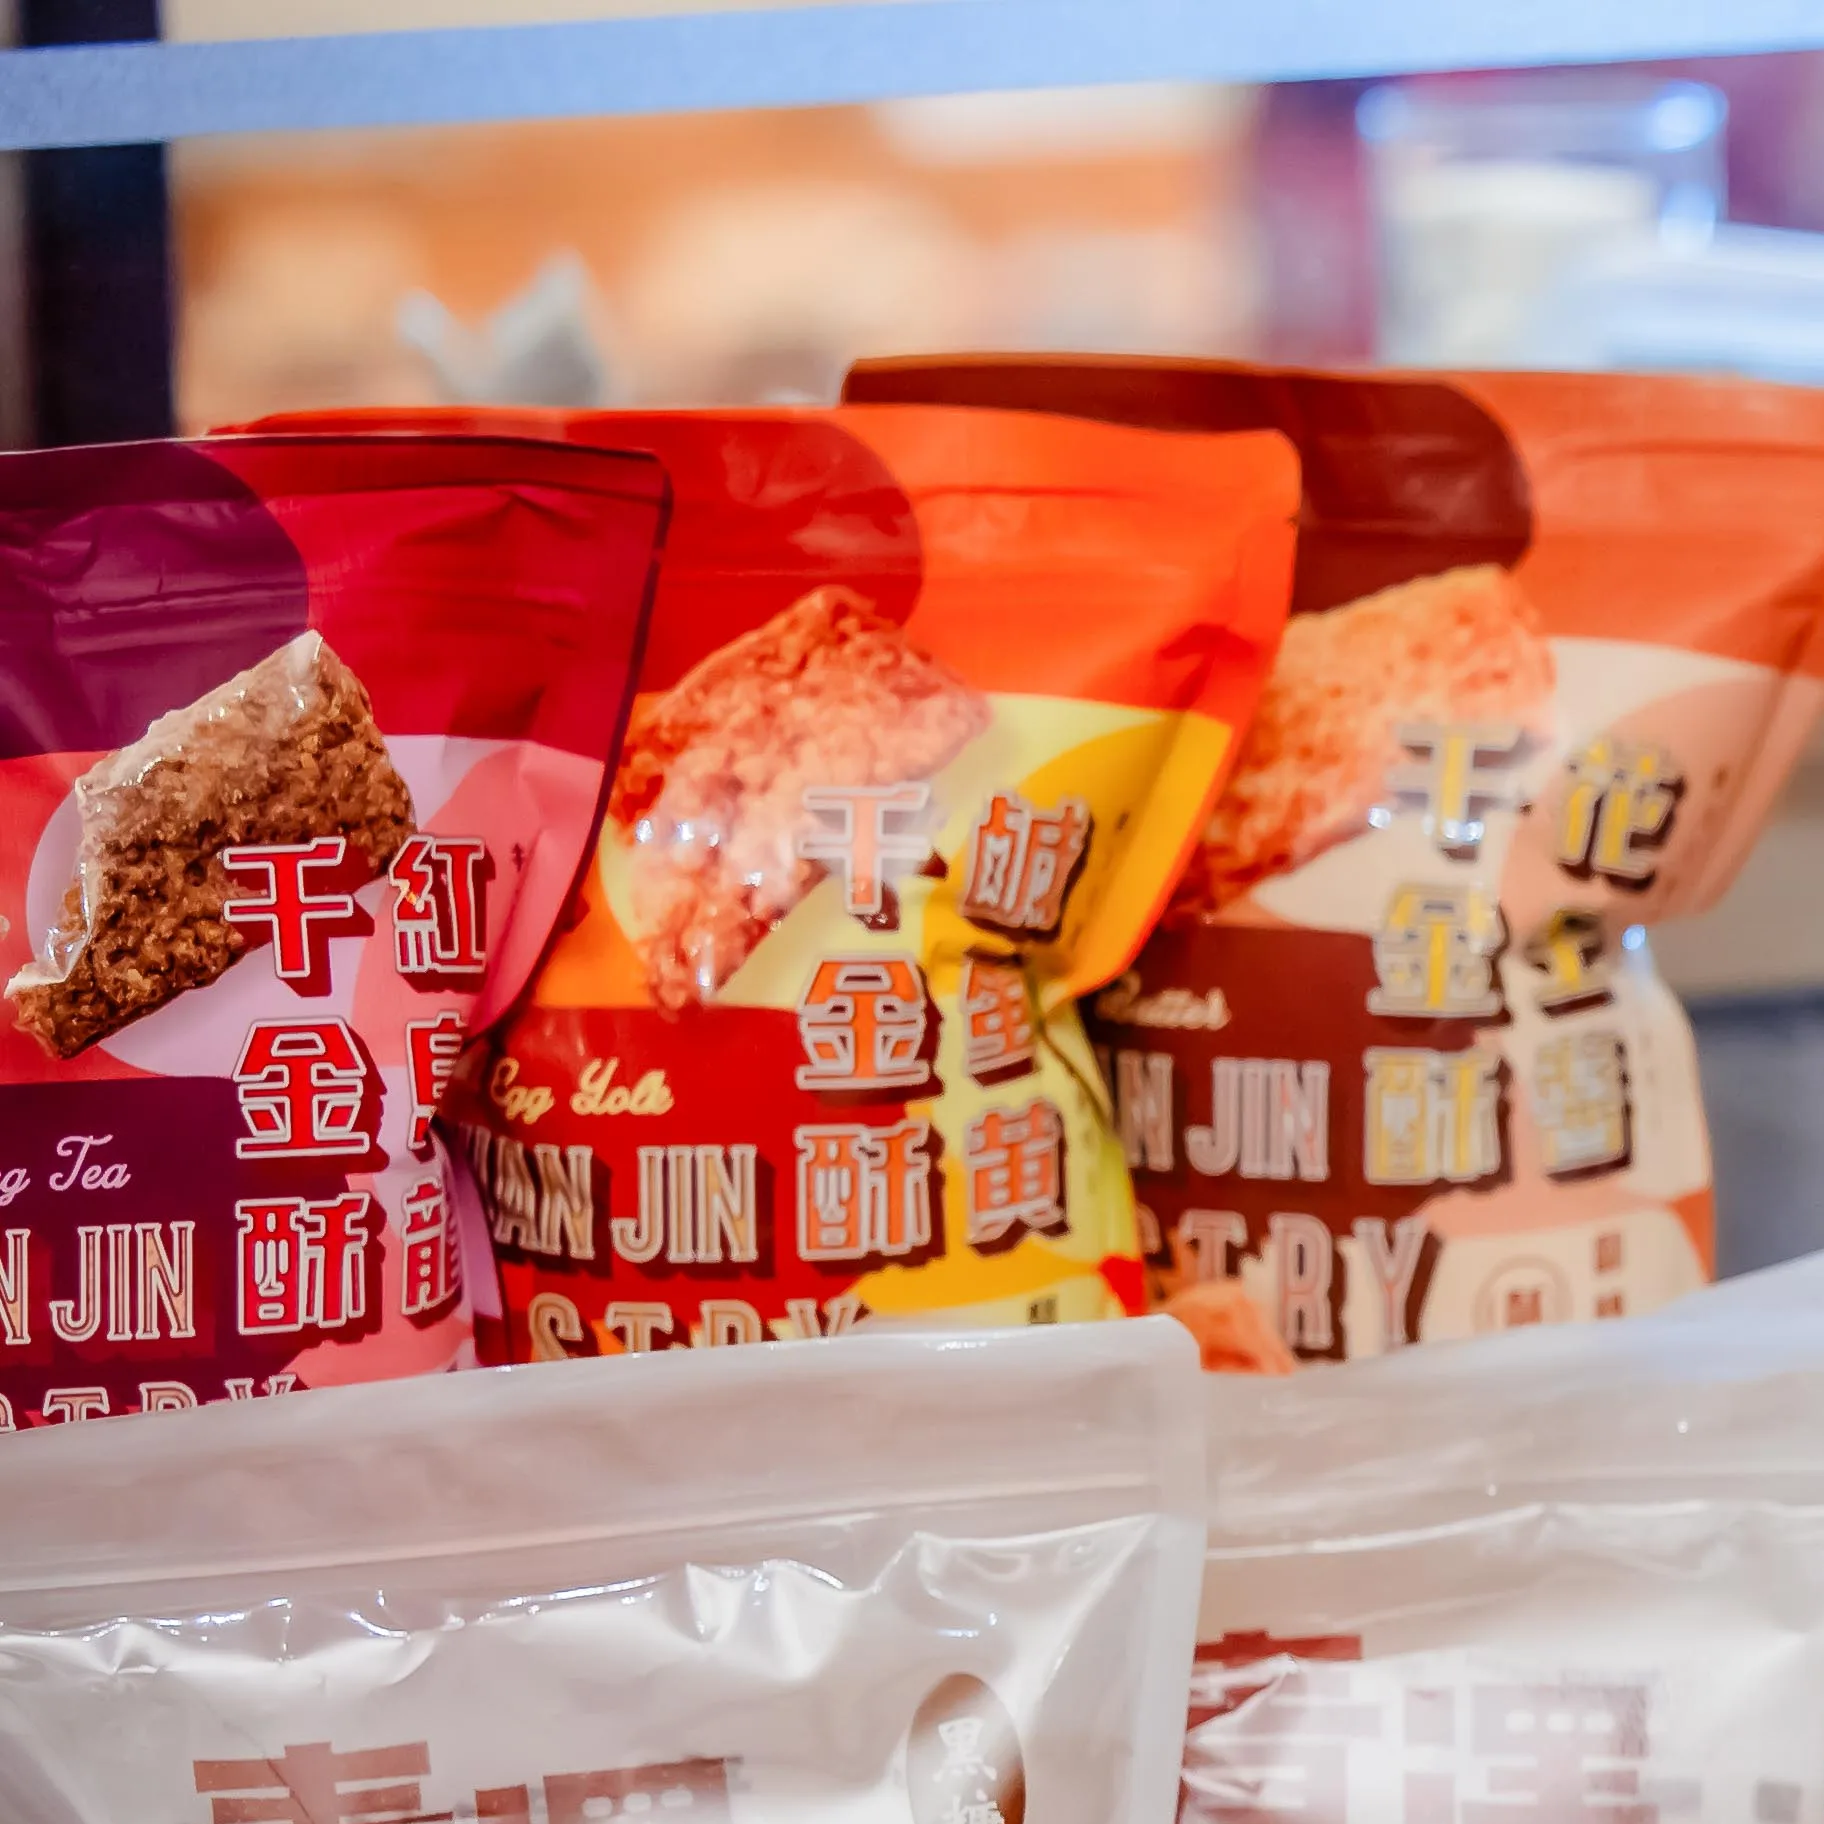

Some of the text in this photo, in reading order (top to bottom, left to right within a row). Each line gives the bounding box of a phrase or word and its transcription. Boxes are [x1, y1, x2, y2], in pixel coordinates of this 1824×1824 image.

[793, 782, 932, 1261] 千金酥
[223, 837, 370, 1336] 千金酥
[1183, 1055, 1330, 1183] JIN
[48, 1133, 132, 1193] Tea
[610, 1143, 759, 1264] JIN
[48, 1220, 196, 1343] JIN
